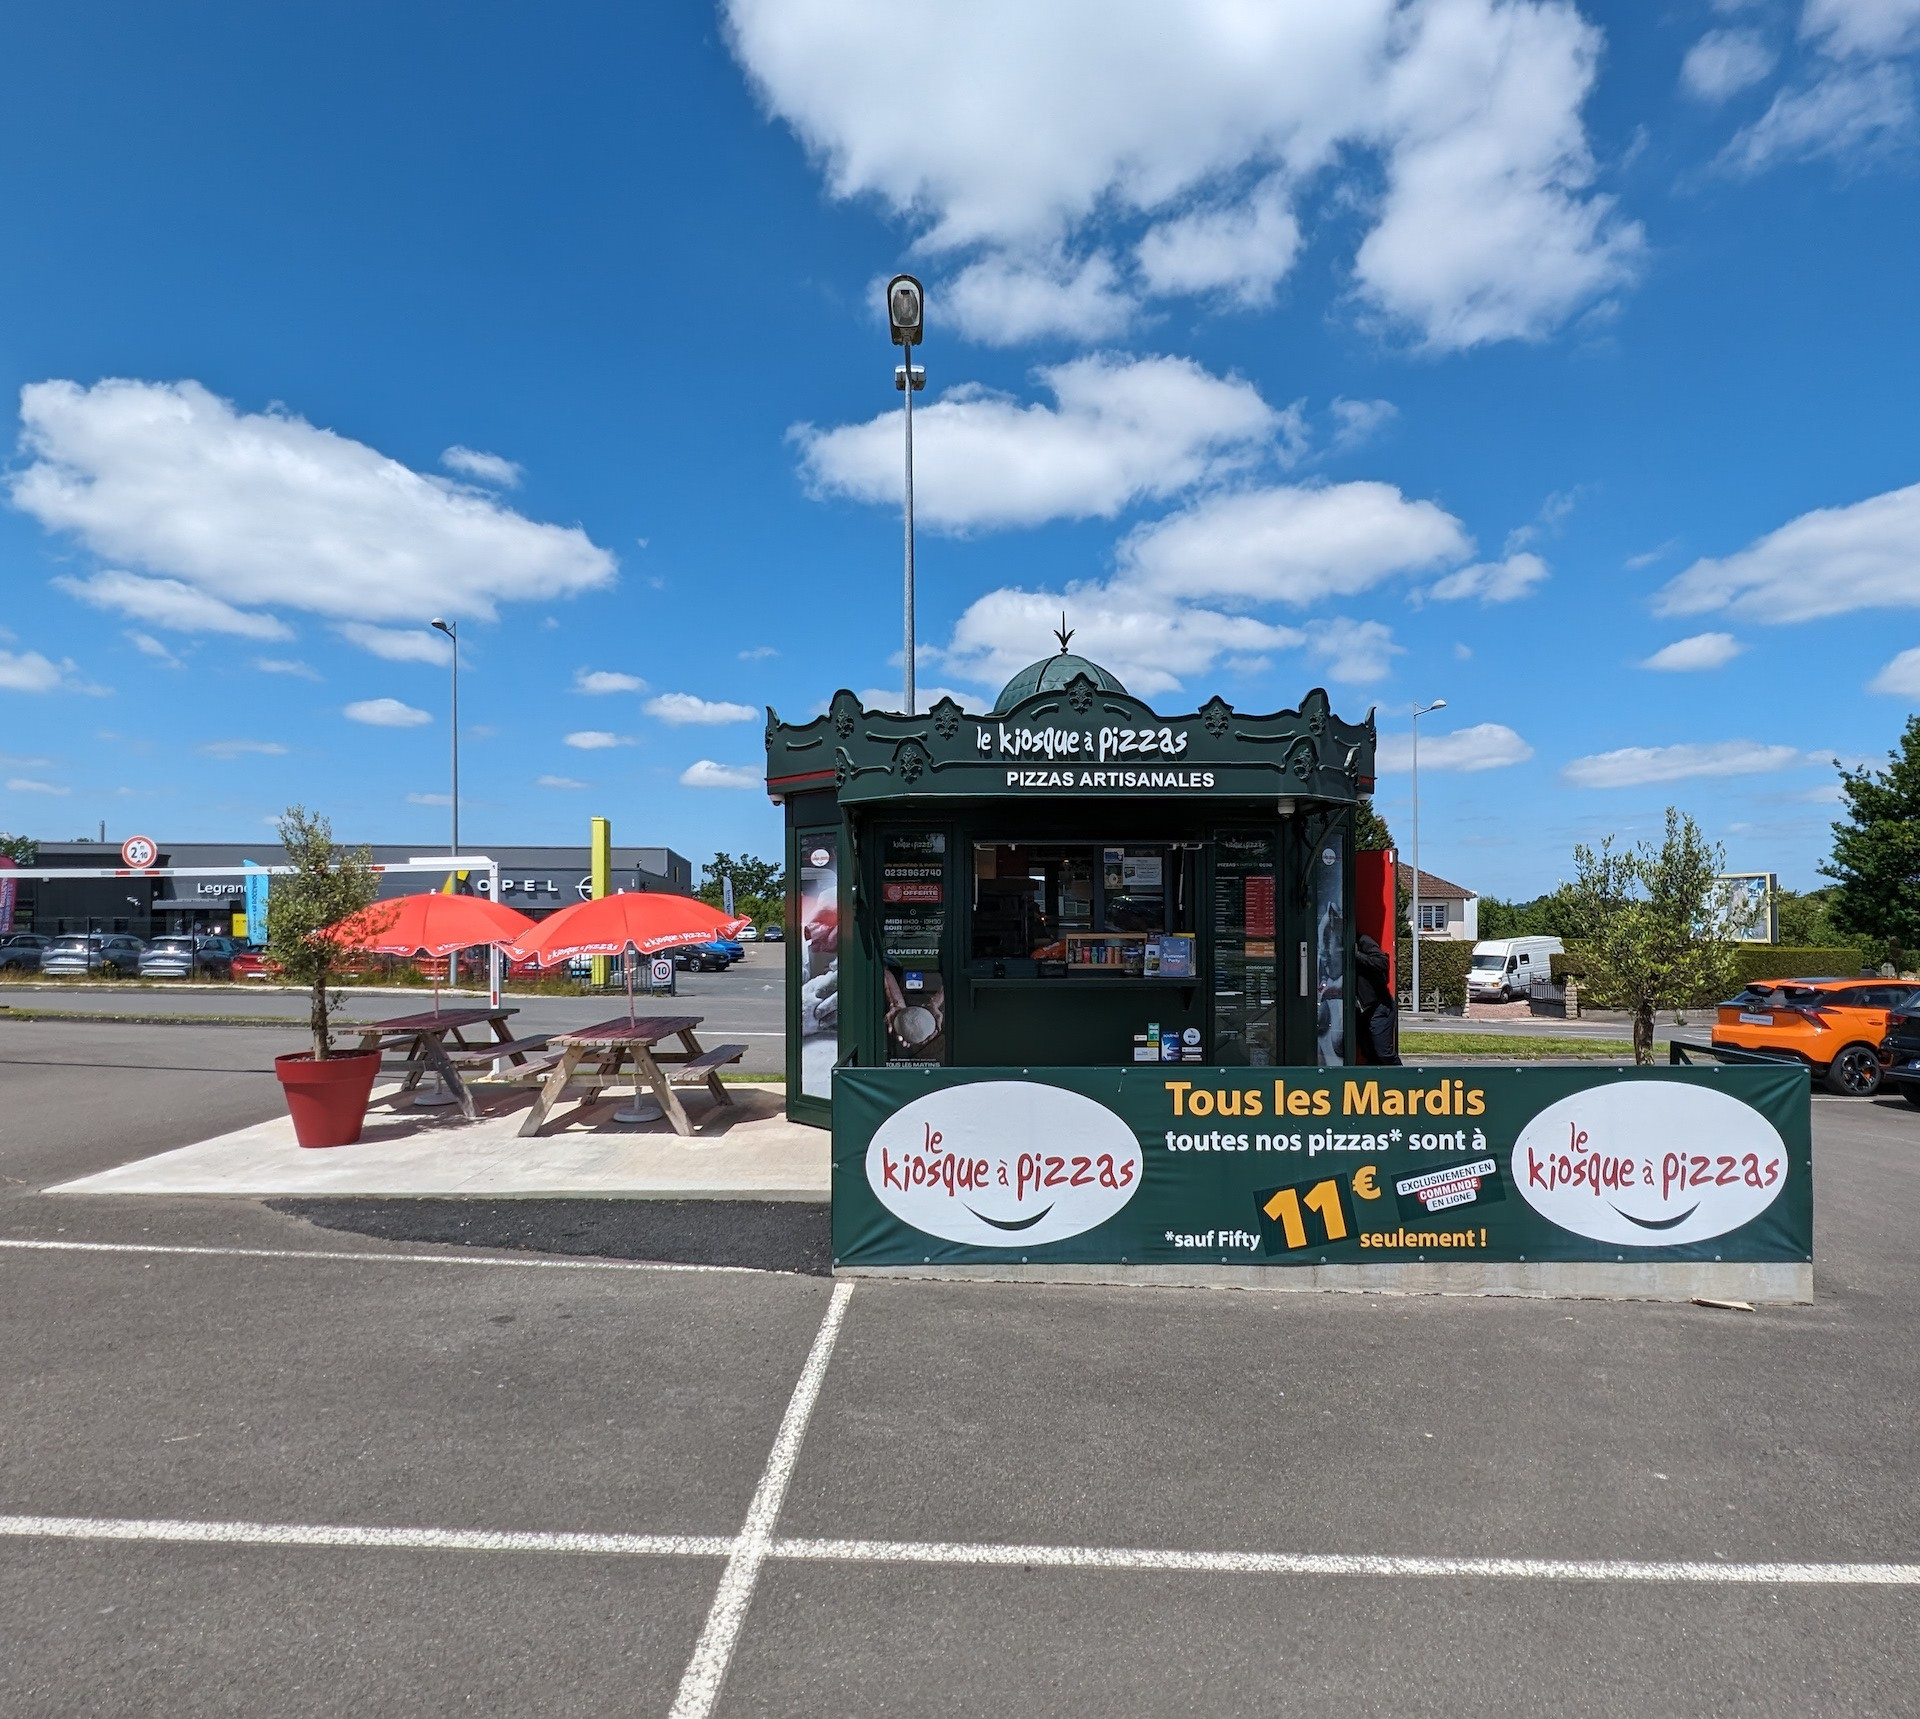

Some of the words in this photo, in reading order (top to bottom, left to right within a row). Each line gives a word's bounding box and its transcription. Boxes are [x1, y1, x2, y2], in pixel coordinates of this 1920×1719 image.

[976, 726, 992, 750] le
[998, 723, 1080, 760] kiosque
[1084, 732, 1095, 752] à
[1099, 726, 1188, 763] pizzas
[1006, 771, 1075, 788] PIZZAS
[1079, 772, 1215, 788] ARTISANALES
[130, 847, 138, 859] 2
[477, 879, 558, 892] OPEL
[657, 966, 667, 975] 10
[1164, 1081, 1263, 1116] Tous
[1274, 1079, 1332, 1116] les
[1342, 1079, 1486, 1116] Mardis
[924, 1122, 943, 1153] le
[1165, 1130, 1249, 1152] toutes
[1255, 1132, 1302, 1152] nos
[1408, 1131, 1466, 1152] sont
[1472, 1128, 1487, 1151] à
[1570, 1121, 1588, 1153] le
[882, 1147, 990, 1197] kiosque
[996, 1158, 1009, 1186] à
[1017, 1153, 1134, 1201] pizzas
[1401, 1165, 1477, 1192] EXCLUSIVEMENT
[1478, 1162, 1492, 1173] EN
[1528, 1147, 1635, 1196] kiosque
[1642, 1158, 1655, 1186] à
[1662, 1152, 1779, 1201] pizzas
[1419, 1178, 1478, 1201] COMMANDE
[1432, 1197, 1445, 1208] EN
[1446, 1191, 1472, 1205] LIGNE
[1262, 1179, 1348, 1250] 11
[1351, 1165, 1382, 1200] €
[1218, 1230, 1261, 1251] Fifty
[1360, 1228, 1477, 1247] seulement
[1480, 1229, 1487, 1247] !
